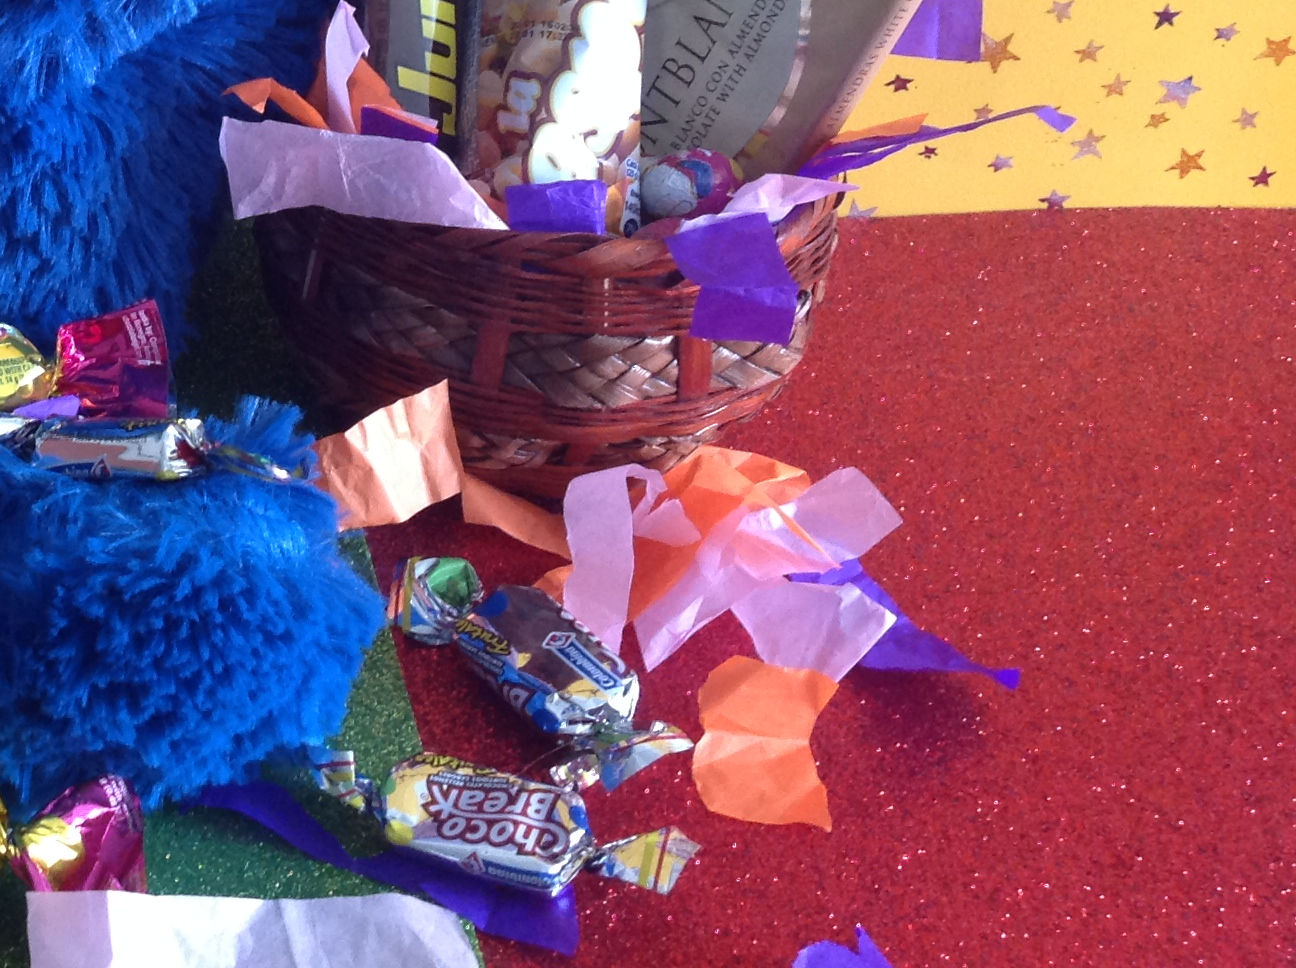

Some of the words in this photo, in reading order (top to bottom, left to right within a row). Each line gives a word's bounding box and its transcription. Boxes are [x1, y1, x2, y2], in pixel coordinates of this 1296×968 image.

[497, 78, 541, 132] la
[670, 93, 709, 151] BLANCO
[702, 58, 730, 94] CON
[714, 61, 748, 105] WITH
[565, 644, 615, 689] Colombina
[429, 785, 556, 819] Break
[441, 818, 569, 859] Choco
